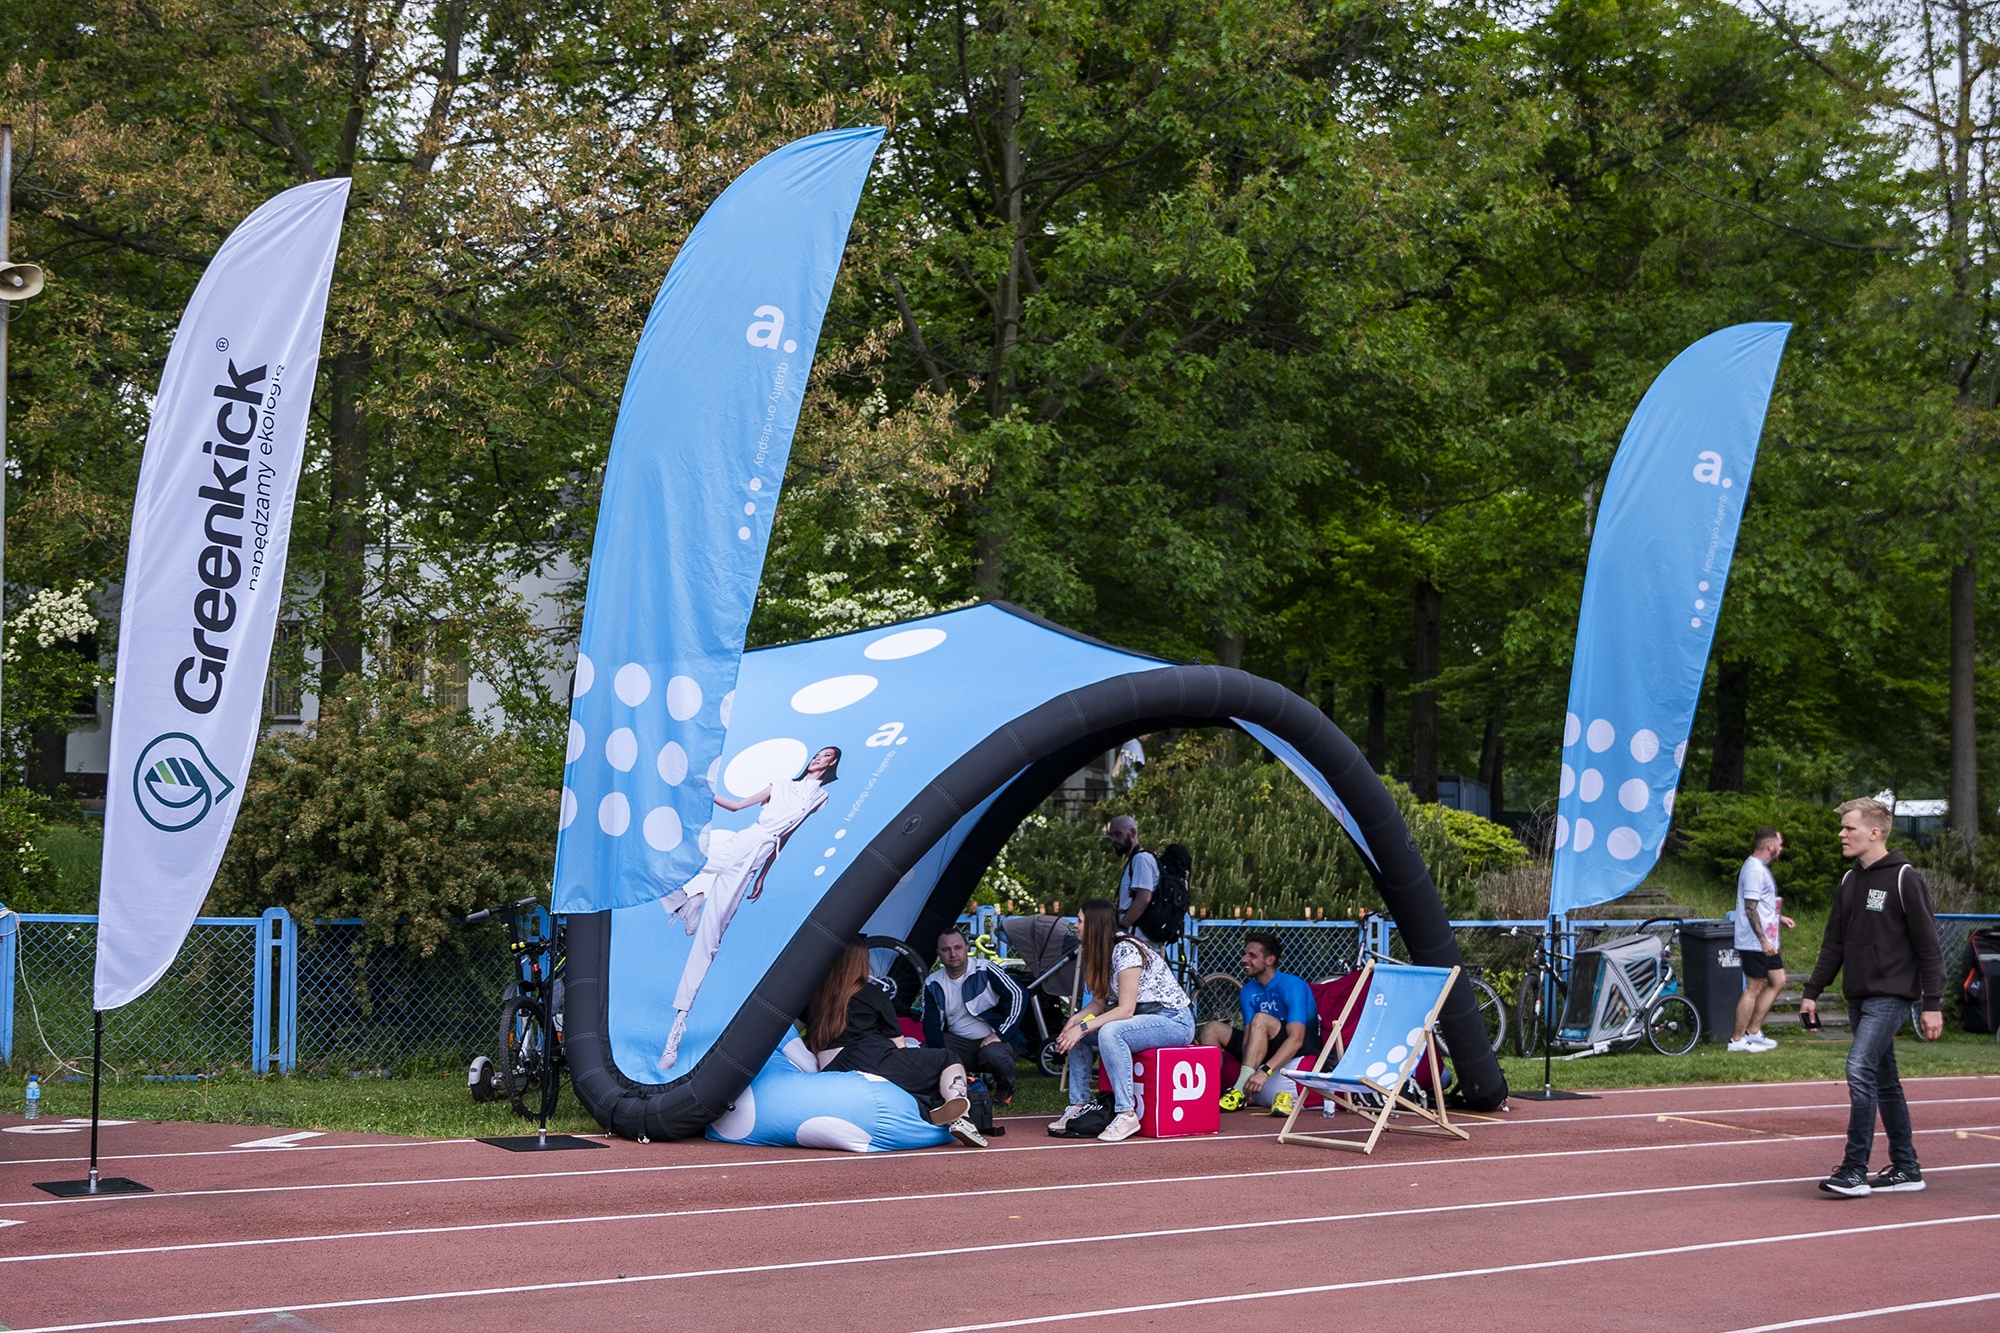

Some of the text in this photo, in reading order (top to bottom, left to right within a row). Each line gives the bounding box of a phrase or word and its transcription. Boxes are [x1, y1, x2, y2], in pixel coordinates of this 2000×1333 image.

[753, 362, 789, 468] quality on display
[248, 461, 276, 591] napędzamy
[1711, 528, 1720, 540] on
[1713, 495, 1727, 526] quality
